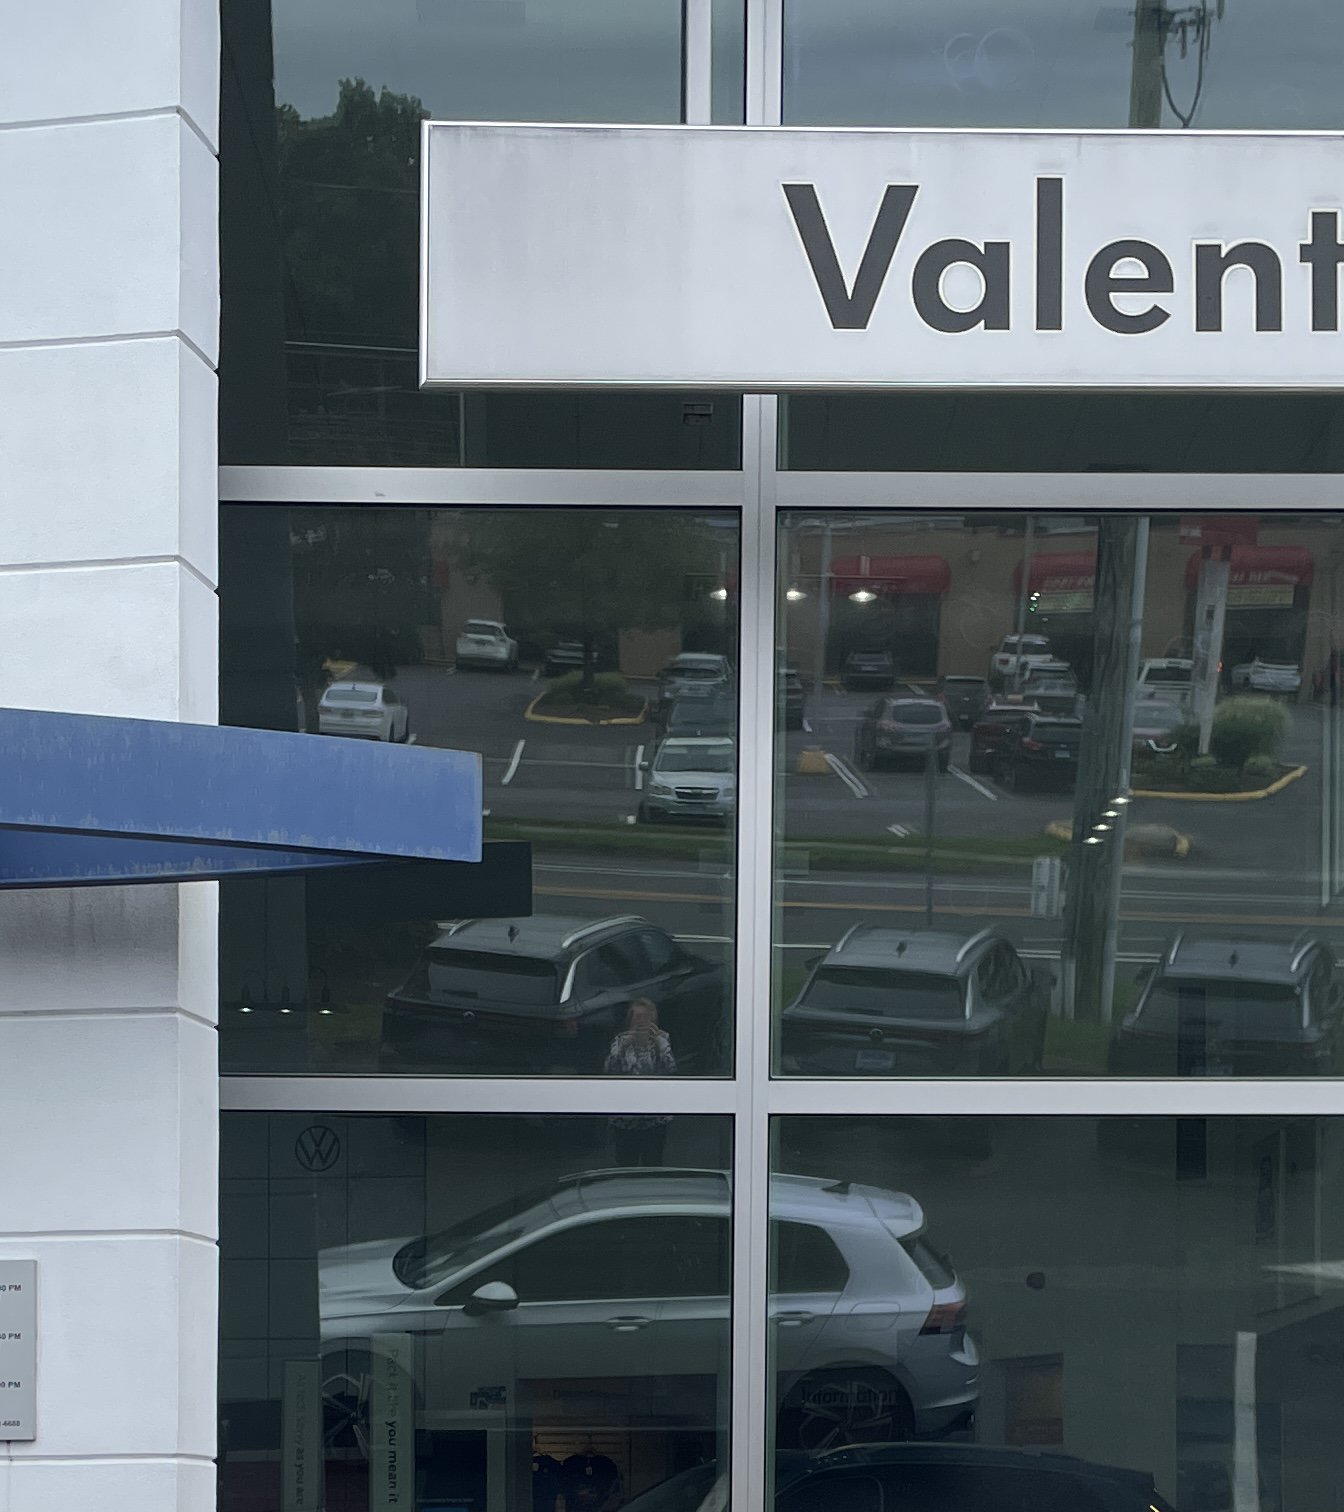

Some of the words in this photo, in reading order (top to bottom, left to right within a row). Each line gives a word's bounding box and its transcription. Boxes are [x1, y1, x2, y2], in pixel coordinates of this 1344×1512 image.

[8, 1284, 22, 1292] PM
[385, 1421, 397, 1446] you
[294, 1463, 304, 1484] you
[388, 1450, 397, 1489] mean
[388, 1493, 399, 1504] it
